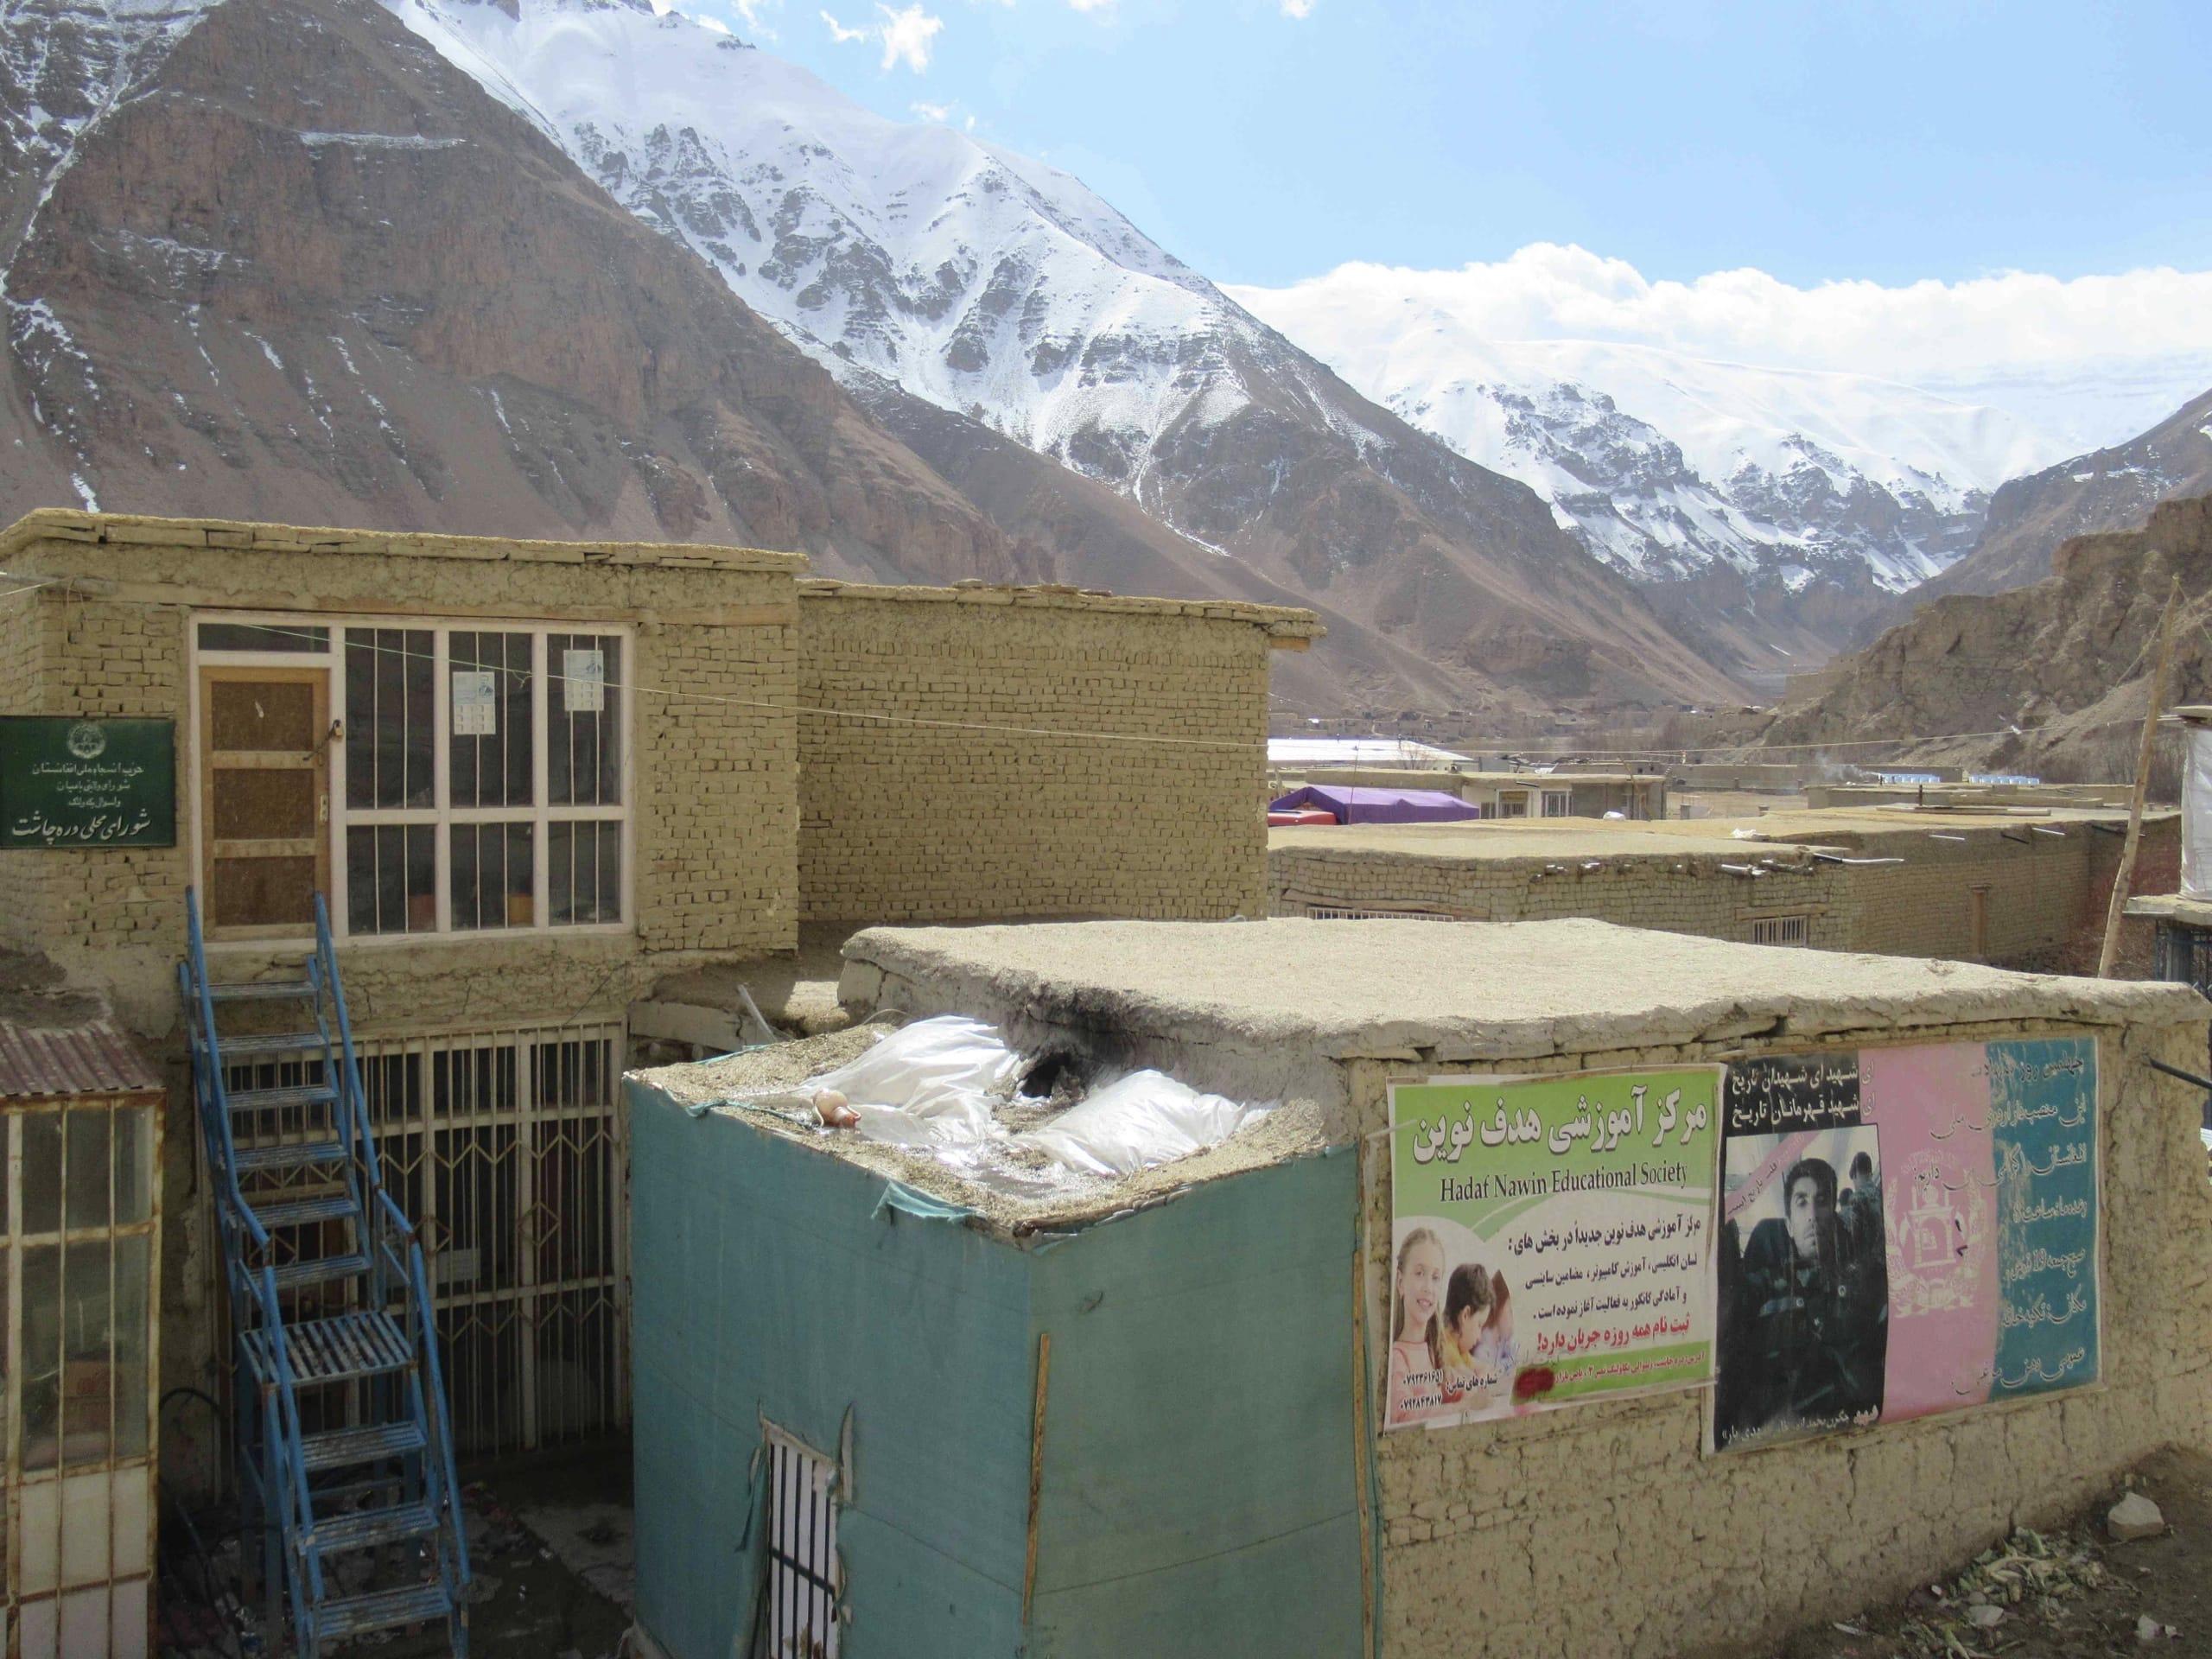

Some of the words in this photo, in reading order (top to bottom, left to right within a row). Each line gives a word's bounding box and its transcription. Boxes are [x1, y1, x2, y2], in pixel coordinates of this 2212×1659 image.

[32, 762, 77, 775] افغانستان
[56, 780, 82, 792] بامیان
[102, 778, 130, 792] شورای
[11, 810, 56, 845] چاشت
[56, 822, 79, 837] دره
[80, 815, 107, 840] محلی
[100, 808, 151, 840] شورای
[1732, 1068, 1759, 1095] تاریخ
[1761, 1065, 1808, 1093] شهیدان
[1809, 1064, 1824, 1089] ای
[1826, 1062, 1859, 1087] شهید
[1861, 1060, 1874, 1085] ای
[2019, 1060, 2040, 1082] روز
[1732, 1100, 1768, 1128] تاریخ
[1771, 1094, 1825, 1125] قهرمانان
[1828, 1094, 1859, 1120] شهید
[1862, 1092, 1875, 1116] ای
[1479, 1096, 1543, 1147] هدف
[1548, 1084, 1648, 1155] آموزشی
[1651, 1087, 1707, 1148] مرکز
[1929, 1104, 1964, 1140] ملی
[1412, 1100, 1476, 1165] نوین
[1440, 1175, 1490, 1202] Hadaf
[1494, 1172, 1548, 1198] Nawin
[1552, 1163, 1637, 1193] Educational
[1641, 1160, 1688, 1189] Society
[1604, 1222, 1625, 1246] نوین
[1624, 1219, 1647, 1238] هدف
[1648, 1213, 1683, 1242] آموزشی
[1684, 1215, 1701, 1237] مرکز
[1535, 1229, 1560, 1254] بخش
[1561, 1235, 1573, 1251] در
[1620, 1256, 1646, 1279] آموزش
[1680, 1253, 1698, 1271] لسان
[1525, 1269, 1554, 1290] ساینسی
[1554, 1268, 1584, 1286] مضامین
[1578, 1297, 1595, 1318] آغاز
[1595, 1295, 1621, 1313] فعالیت
[1621, 1297, 1630, 1307] به
[1652, 1286, 1681, 1308] آمادگی
[1682, 1291, 1688, 1304] و
[1556, 1303, 1579, 1319] نموده
[1669, 1312, 1691, 1333] ثبت
[1604, 1327, 1630, 1348] روزه
[1631, 1323, 1651, 1338] همه
[1651, 1316, 1669, 1339] نام
[1537, 1332, 1566, 1357] دارد!
[1567, 1328, 1601, 1351] جریان
[1465, 1376, 1479, 1390] های
[1479, 1371, 1498, 1389] شماره
